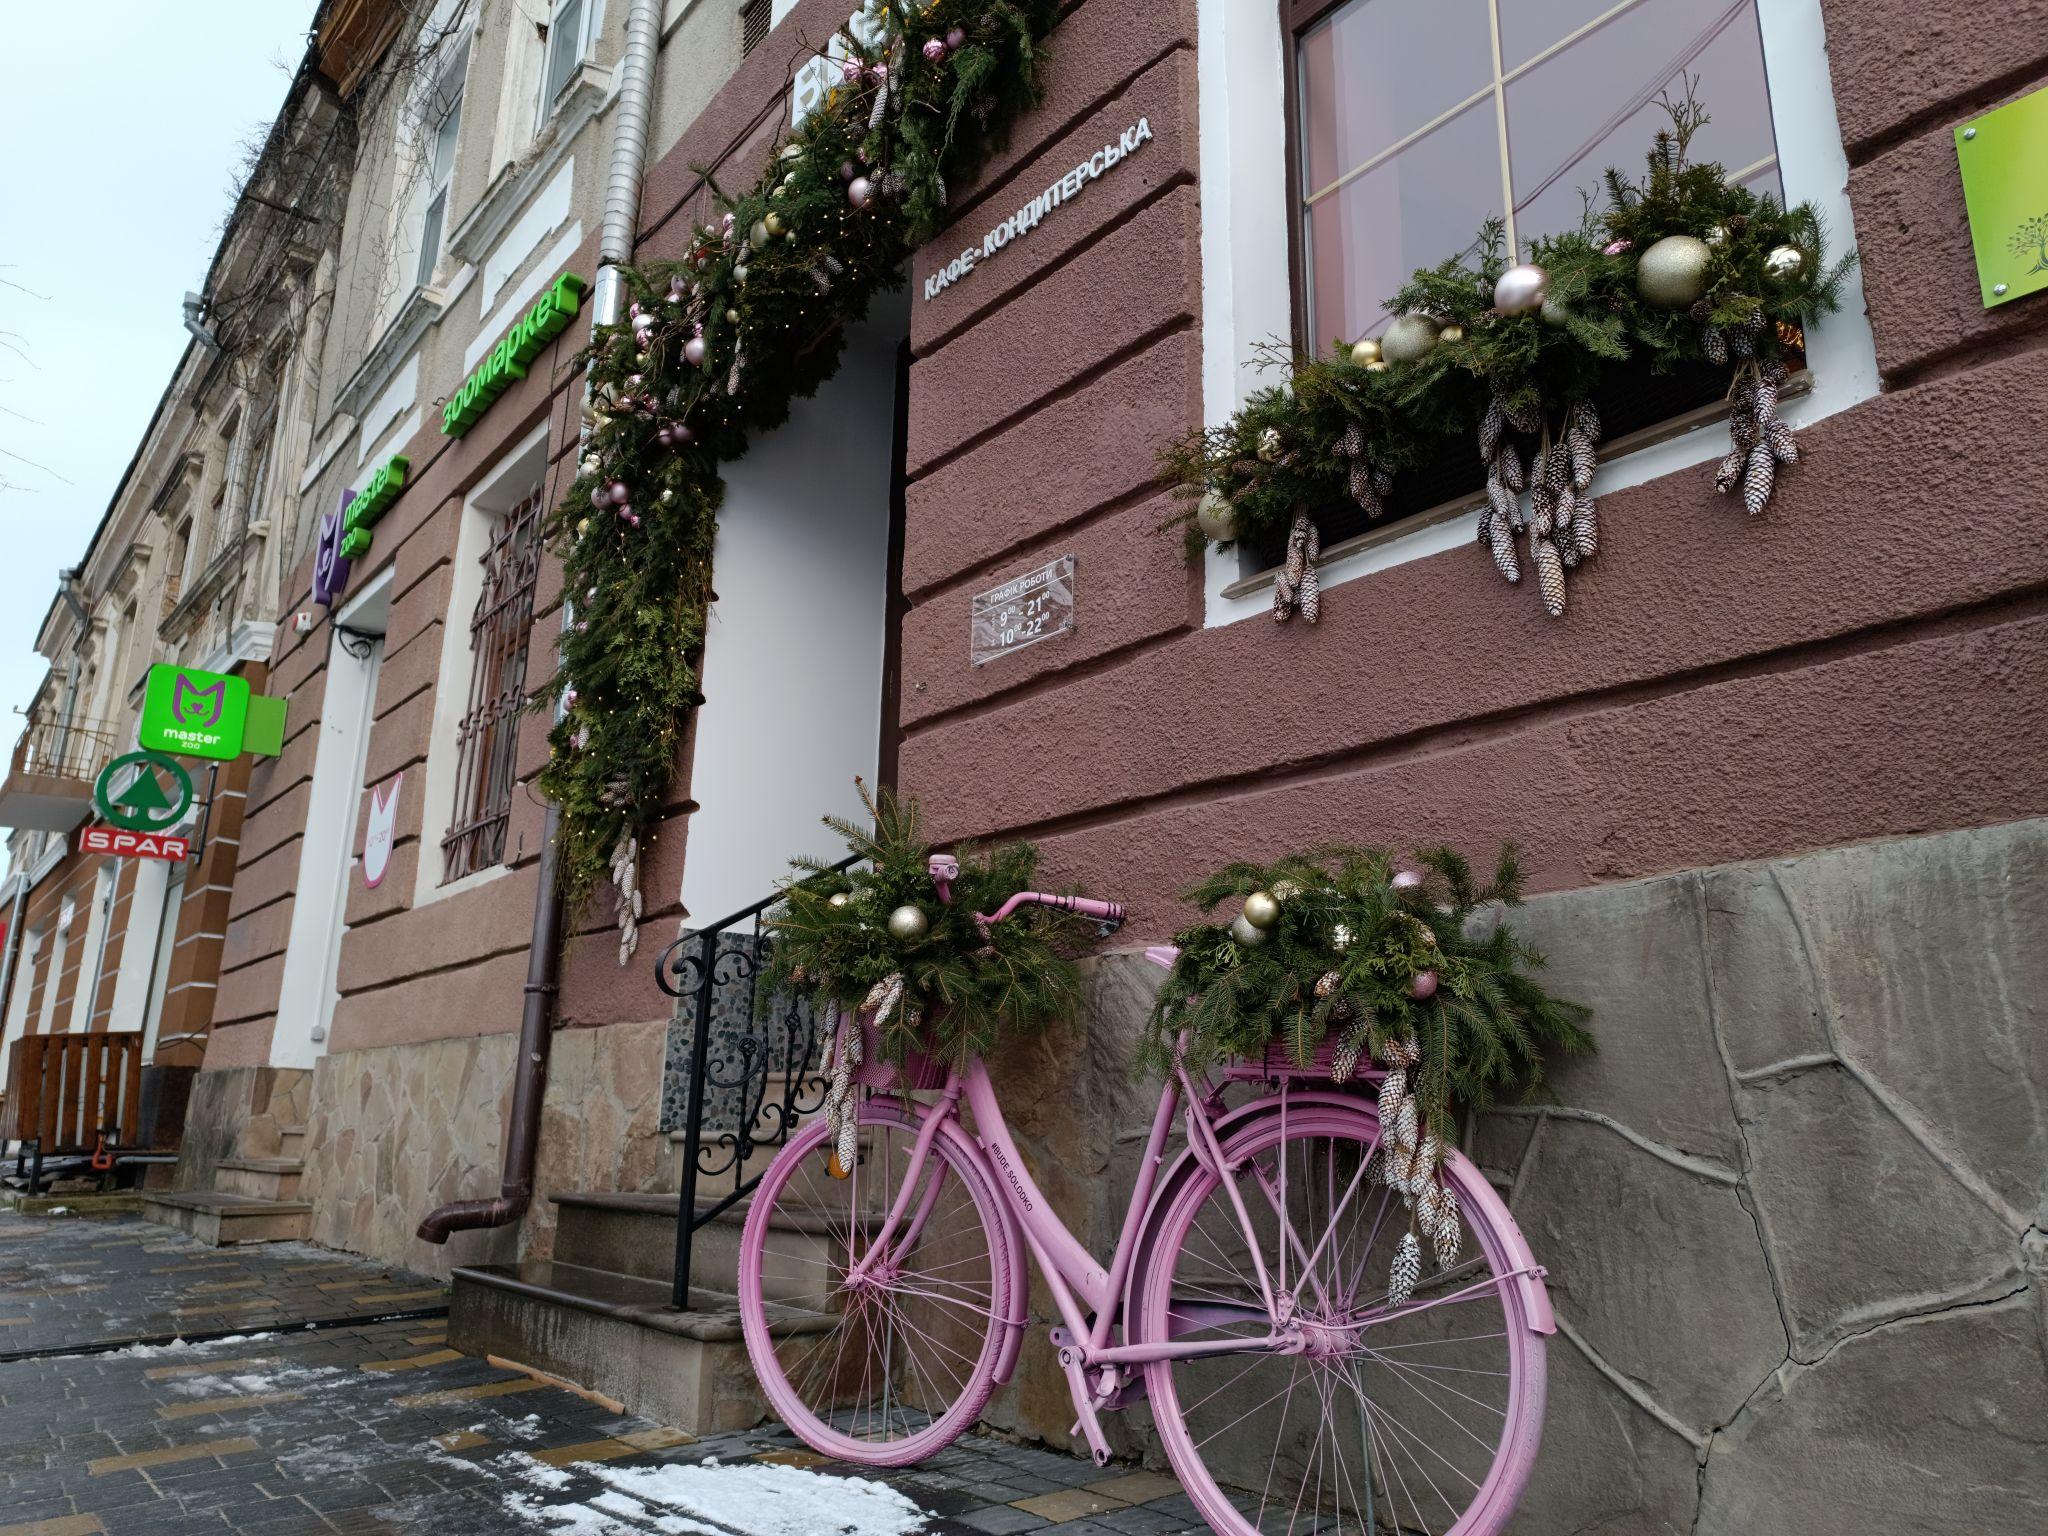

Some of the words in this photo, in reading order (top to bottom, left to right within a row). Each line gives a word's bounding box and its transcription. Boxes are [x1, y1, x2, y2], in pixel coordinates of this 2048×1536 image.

[990, 582, 1018, 604] ГРАФІК
[1019, 568, 1053, 591] РОБОТИ
[163, 727, 222, 746] master
[87, 832, 185, 858] SPAR
